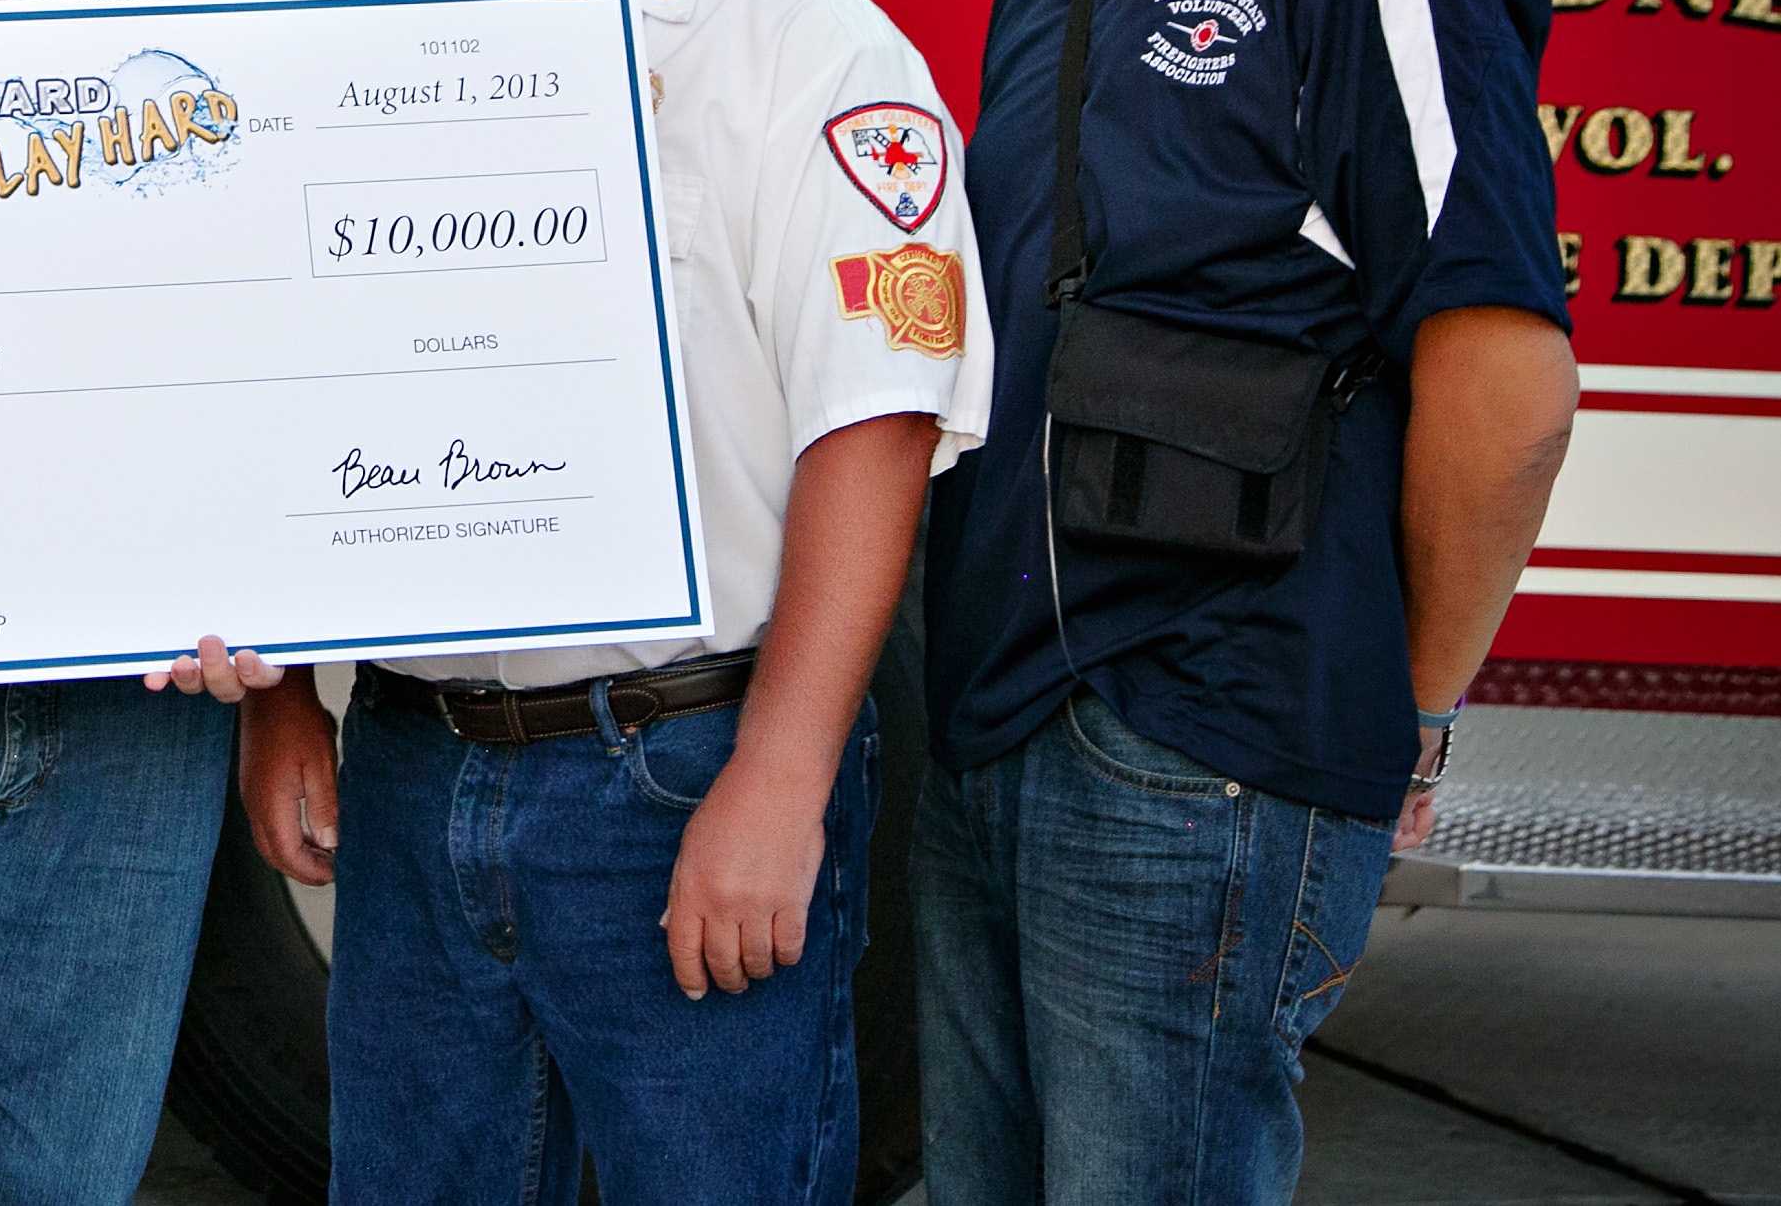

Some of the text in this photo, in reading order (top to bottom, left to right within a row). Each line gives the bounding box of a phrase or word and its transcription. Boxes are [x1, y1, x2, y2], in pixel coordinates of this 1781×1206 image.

[1168, 0, 1253, 36] VOLUNTEER
[421, 39, 479, 54] 101102
[1147, 31, 1236, 71] FIREFIGHTERS
[1140, 51, 1227, 85] ASSOCIATION
[249, 72, 559, 132] DATE August 1, 2013
[98, 89, 239, 167] HARD
[329, 206, 588, 261] $10,000.00
[414, 334, 498, 353] DOLLARS
[332, 439, 566, 499] Beau Brown
[332, 517, 559, 545] AUTHORIZED SIGNATURE
